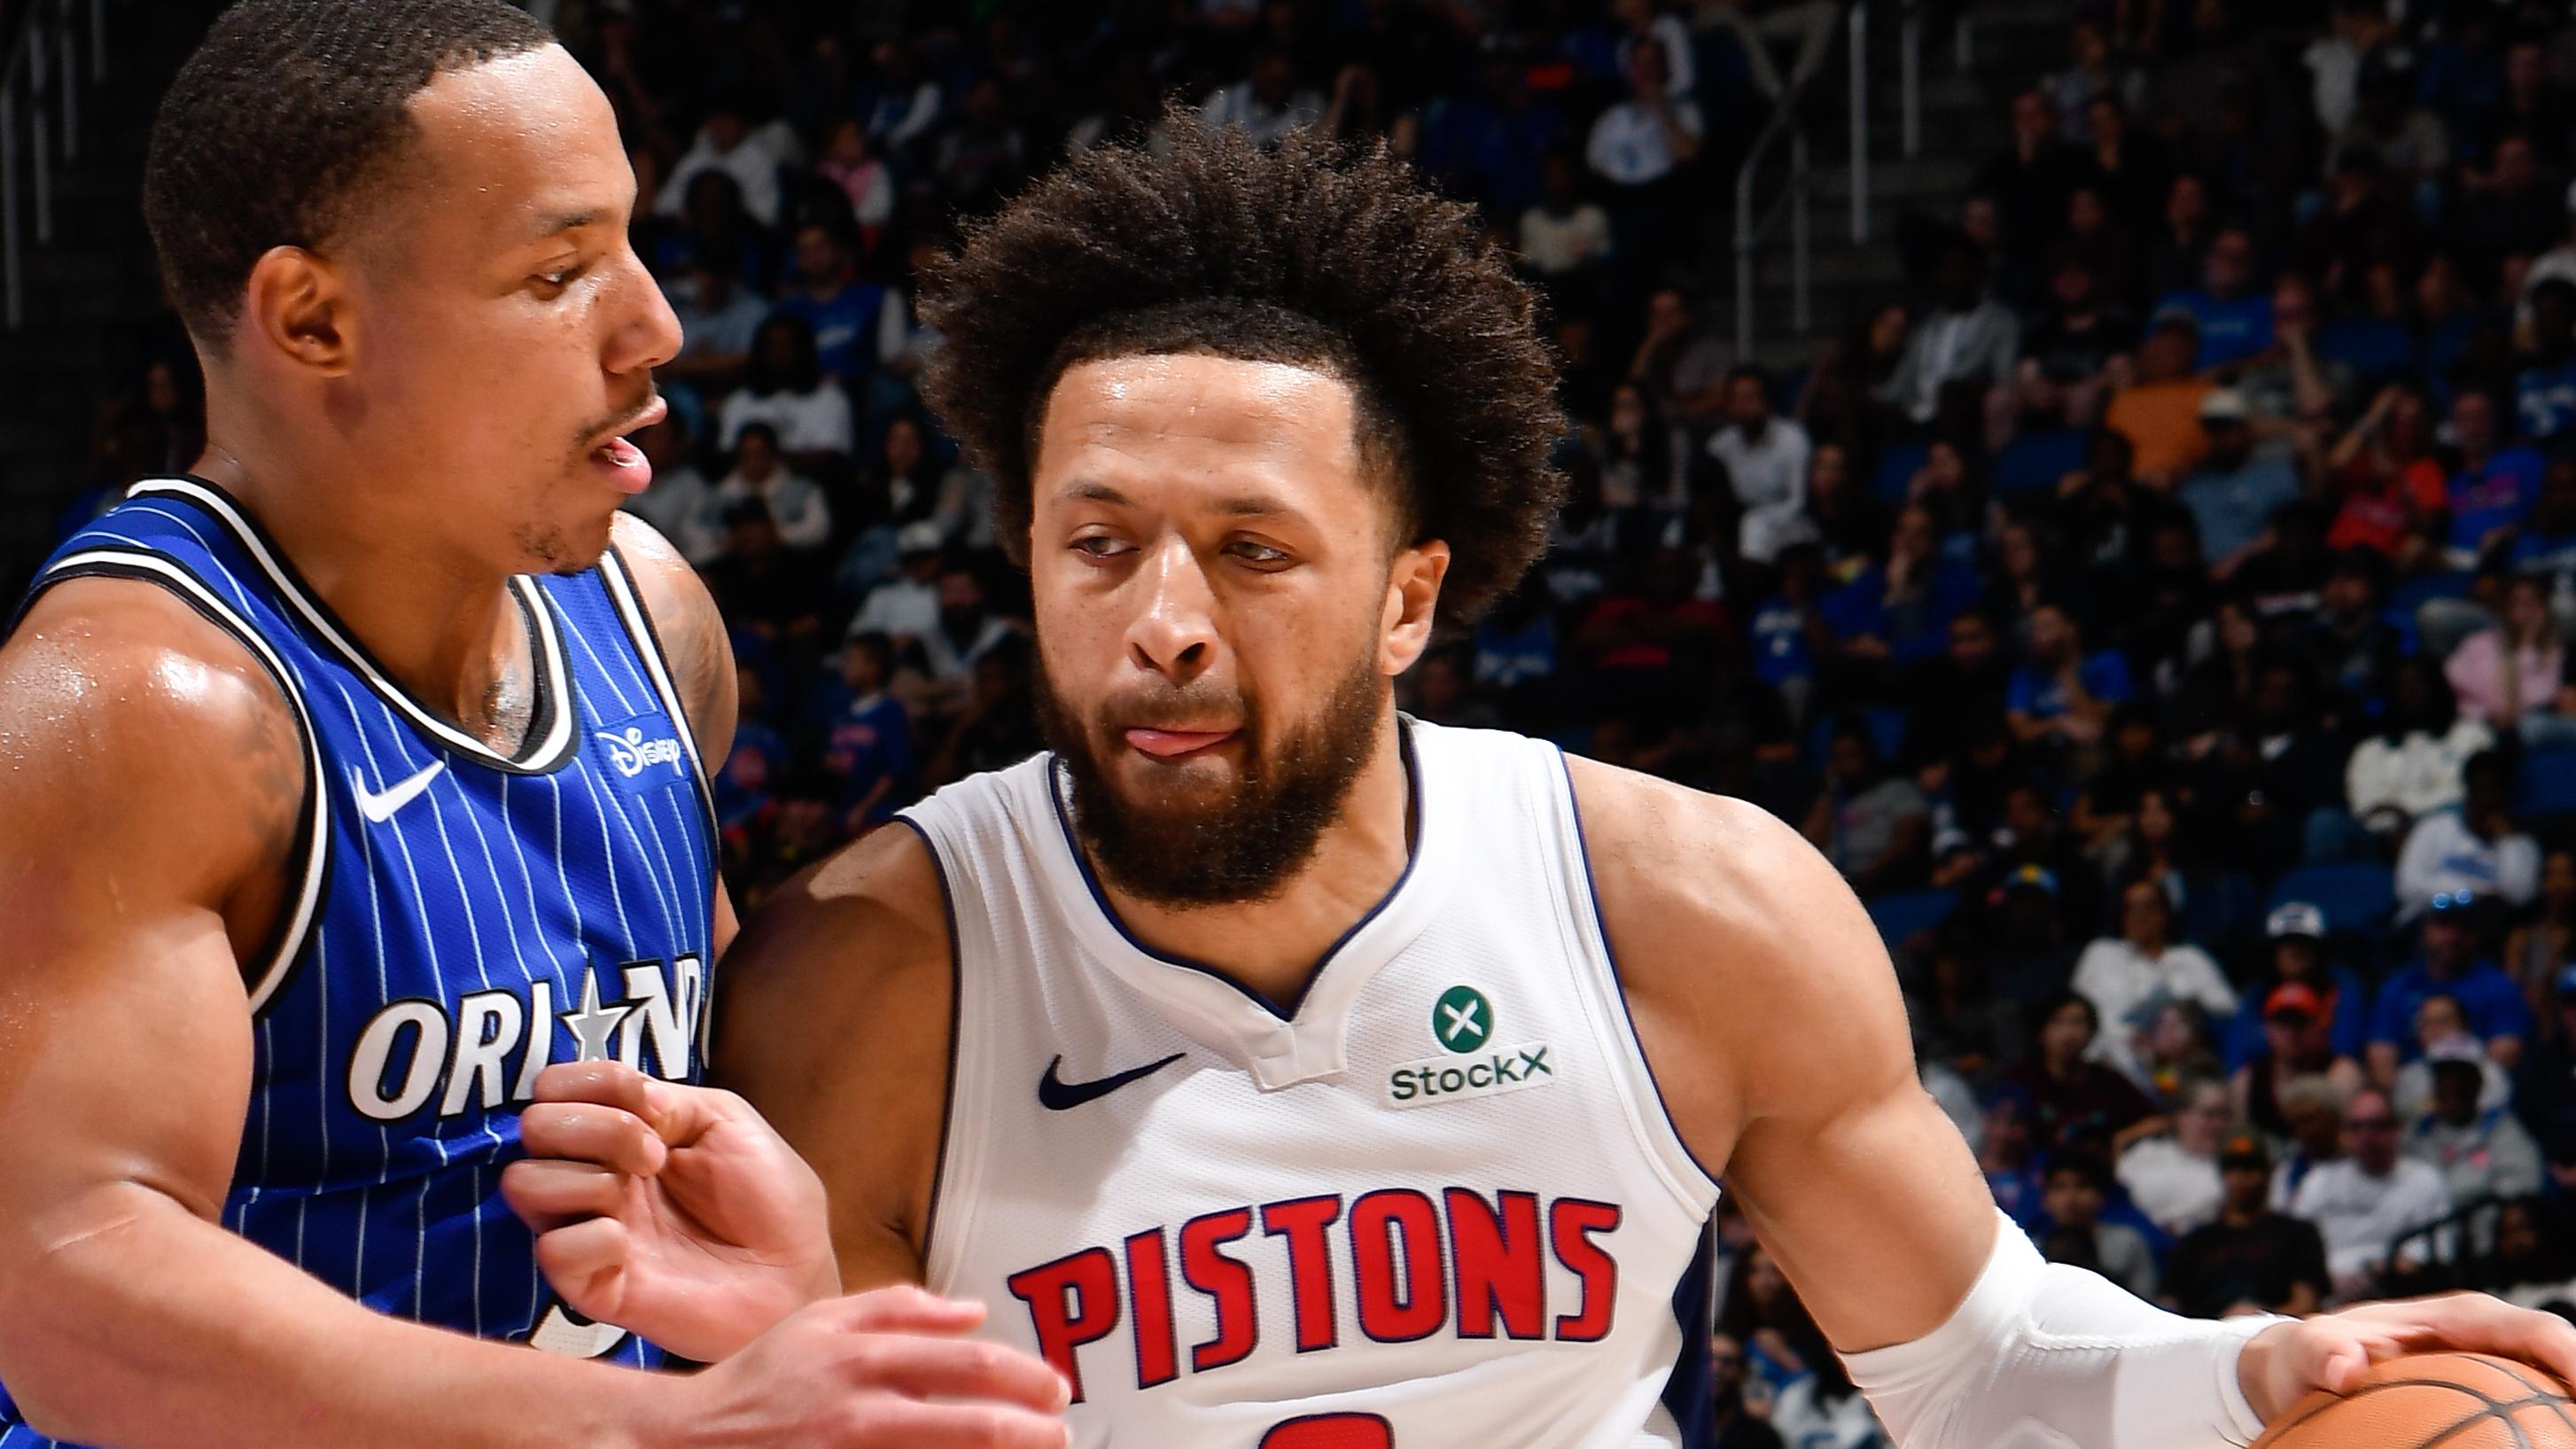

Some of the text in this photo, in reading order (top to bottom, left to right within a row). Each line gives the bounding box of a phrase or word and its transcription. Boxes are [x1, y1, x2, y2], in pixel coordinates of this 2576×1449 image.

[595, 727, 683, 778] Disney
[1391, 1046, 1553, 1100] StockX
[1008, 1186, 1623, 1405] PISTONS
